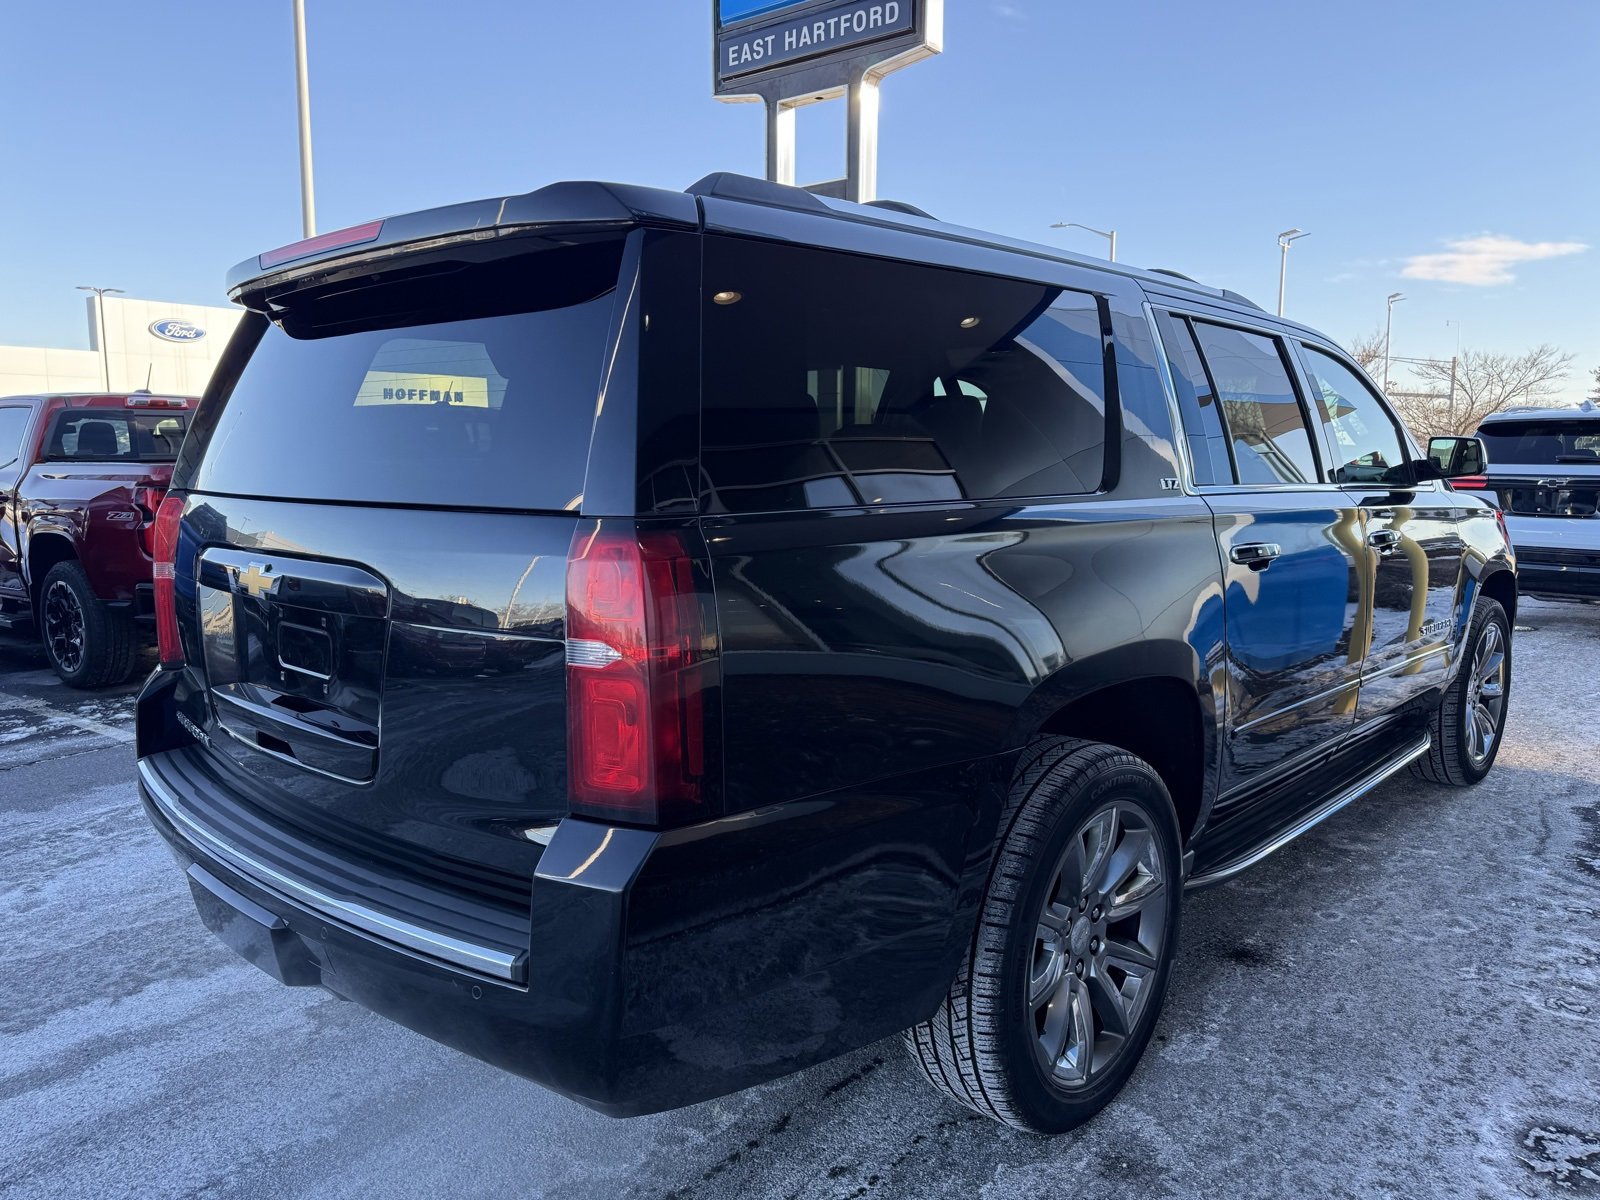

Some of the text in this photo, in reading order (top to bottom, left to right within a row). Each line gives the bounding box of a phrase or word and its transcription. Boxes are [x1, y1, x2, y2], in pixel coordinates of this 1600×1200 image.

[728, 1, 899, 66] EAST HARTFORD
[164, 322, 197, 338] Ford
[383, 388, 464, 403] HOFFMAN
[1090, 774, 1152, 800] CONTINENTAL
